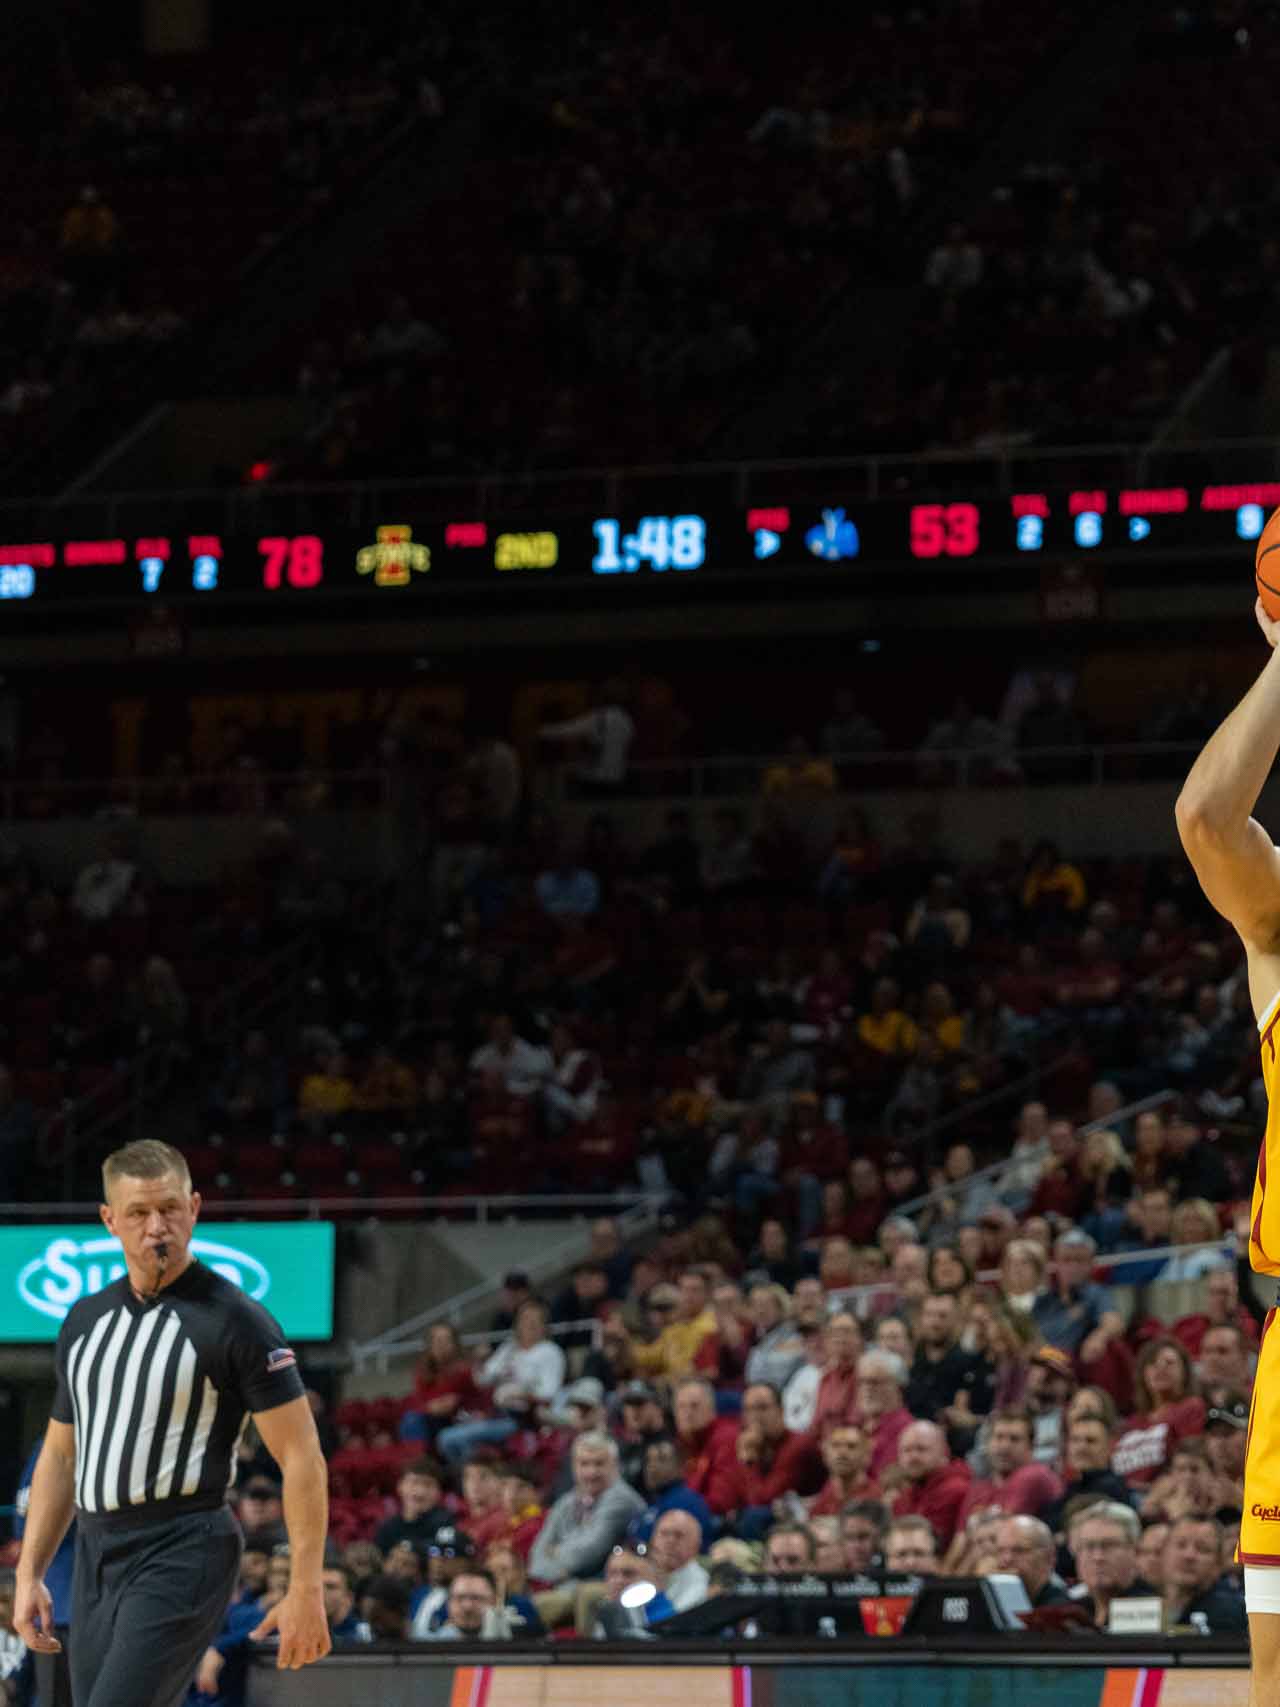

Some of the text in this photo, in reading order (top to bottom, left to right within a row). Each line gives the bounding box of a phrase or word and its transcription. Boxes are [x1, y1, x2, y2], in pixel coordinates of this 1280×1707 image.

[592, 514, 706, 573] 1:48
[910, 503, 979, 557] 53
[258, 535, 323, 588] 78
